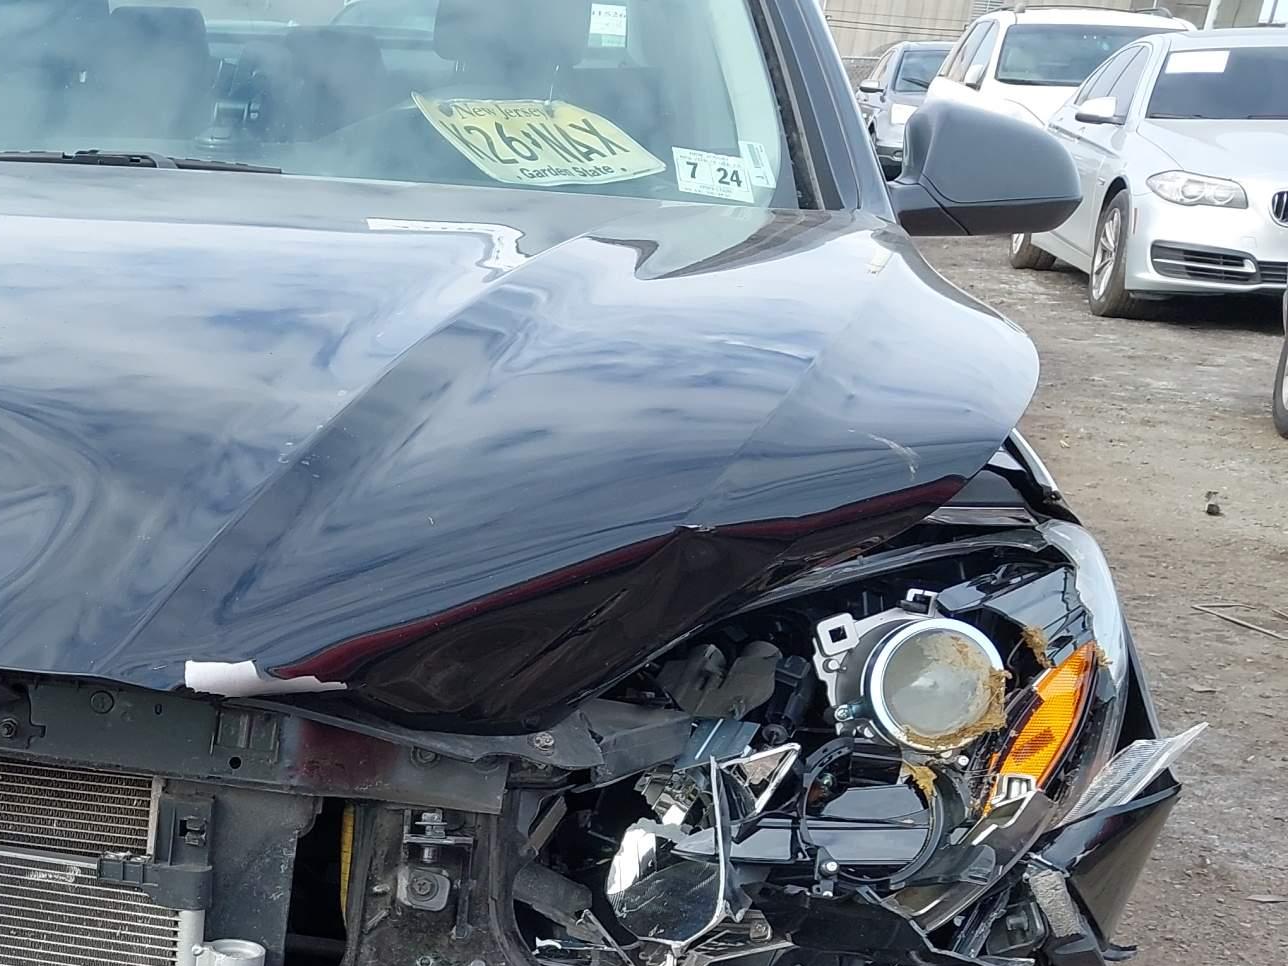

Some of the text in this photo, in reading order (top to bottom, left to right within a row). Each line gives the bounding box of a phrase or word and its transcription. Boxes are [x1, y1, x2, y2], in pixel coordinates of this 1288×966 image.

[453, 103, 548, 121] New Jersey
[519, 165, 614, 179] Garden State
[686, 161, 743, 188] 7 24
